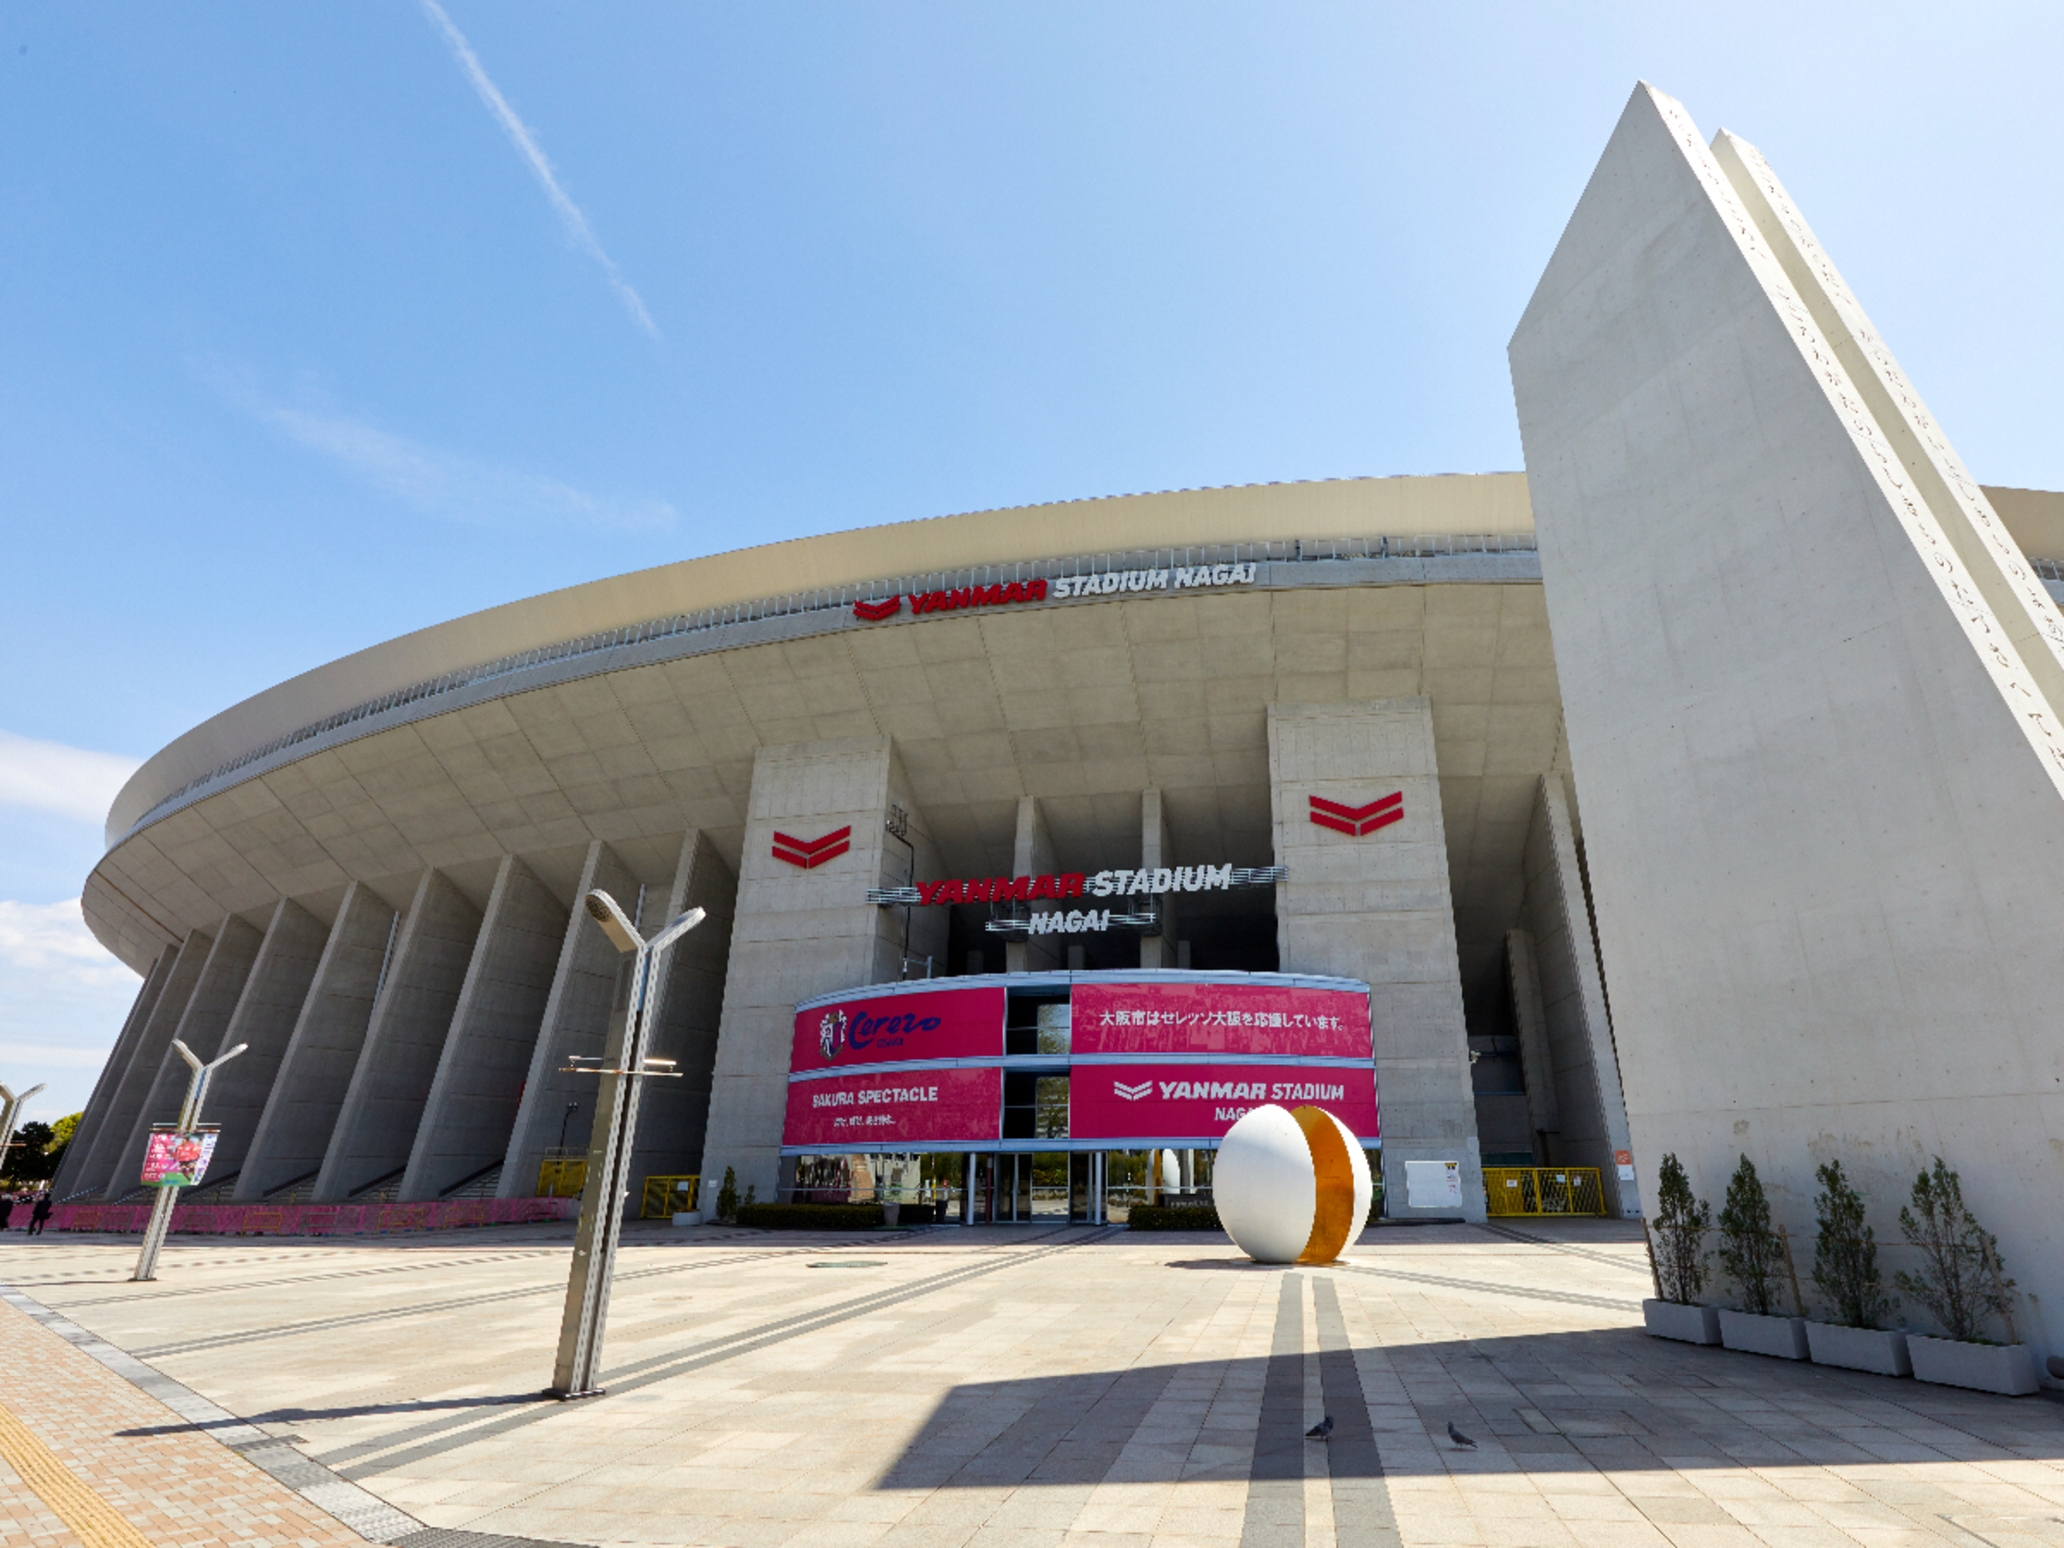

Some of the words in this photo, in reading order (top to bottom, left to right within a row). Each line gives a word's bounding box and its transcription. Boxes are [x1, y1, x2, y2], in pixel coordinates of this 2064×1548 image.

[908, 579, 1048, 614] YANMAR
[1053, 568, 1169, 599] STADIUM
[1174, 563, 1256, 589] NAGAI
[916, 872, 1085, 906] YANMAR
[1091, 863, 1233, 897] STADIUM
[1028, 909, 1110, 935] NAGAI
[848, 1011, 942, 1050] Cerezo
[812, 1092, 854, 1108] SAKURA
[858, 1086, 938, 1105] SPECTACLE
[1159, 1081, 1266, 1100] YANMAR
[1271, 1083, 1344, 1100] STADIUM
[1214, 1107, 1253, 1121] NAG
